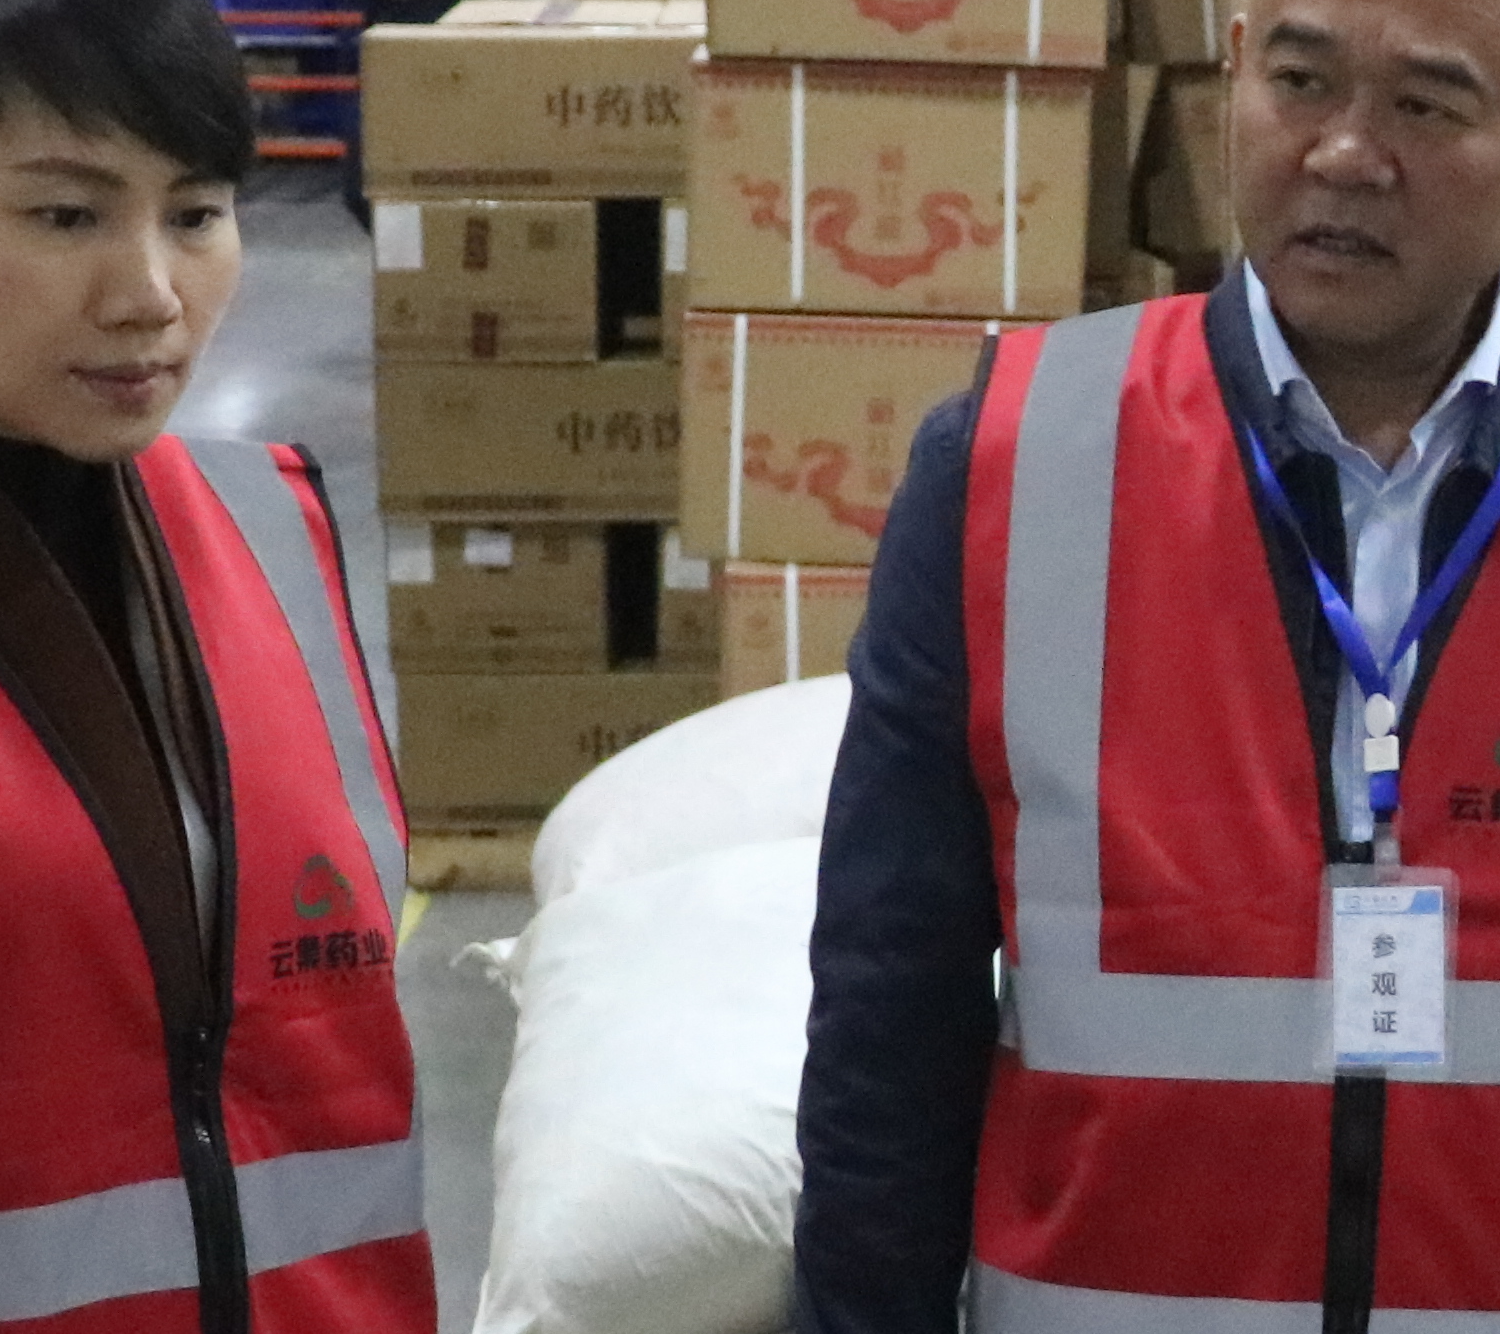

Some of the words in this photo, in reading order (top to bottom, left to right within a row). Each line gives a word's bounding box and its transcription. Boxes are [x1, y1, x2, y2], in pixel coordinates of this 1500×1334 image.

[270, 928, 390, 979] 云集药业
[1371, 932, 1398, 1034] 参观证
